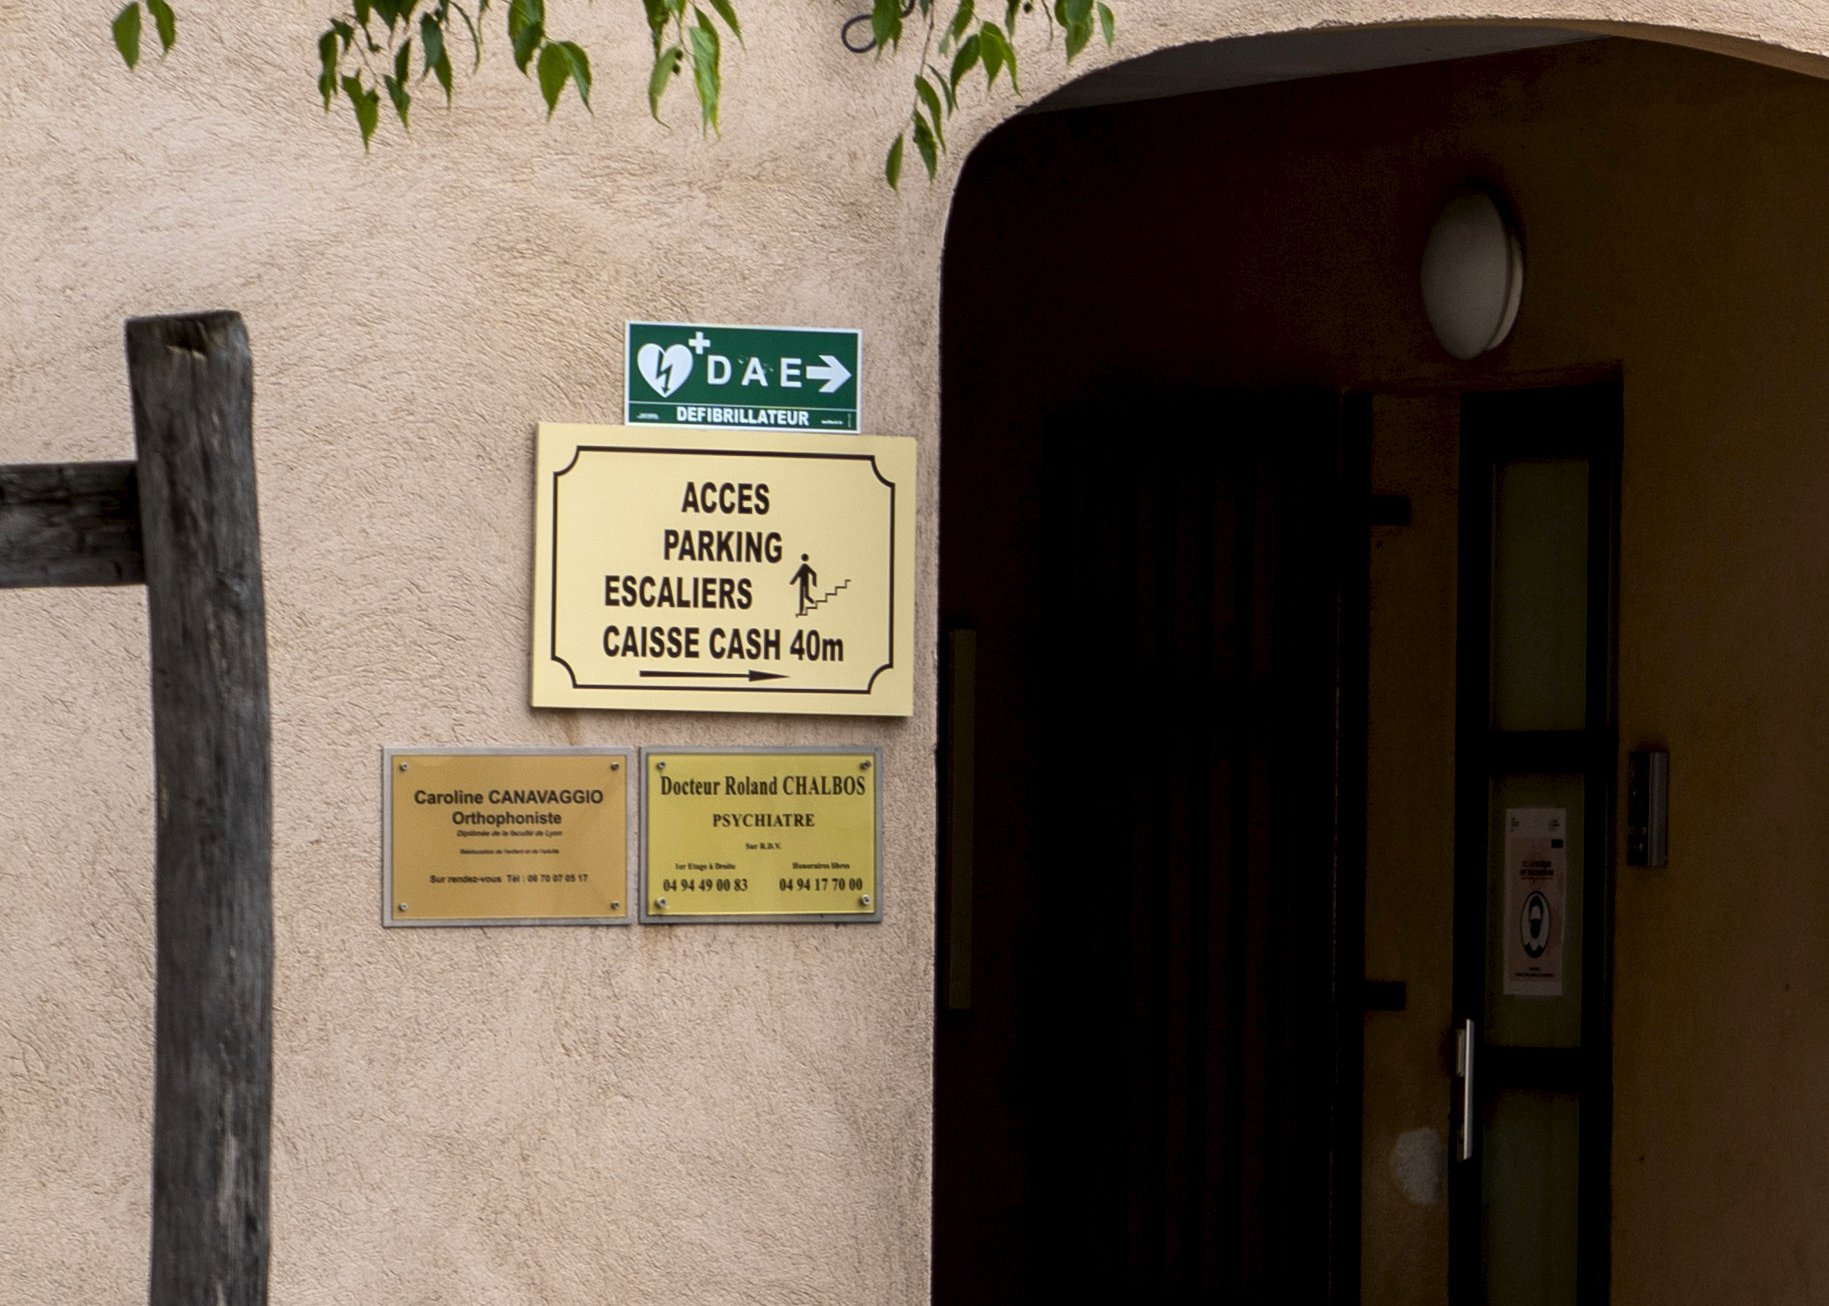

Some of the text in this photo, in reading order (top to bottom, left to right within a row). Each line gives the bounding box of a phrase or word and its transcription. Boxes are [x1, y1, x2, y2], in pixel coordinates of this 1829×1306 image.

[676, 406, 810, 426] DEFIBRILLATEUR
[681, 481, 770, 515] ACCES
[663, 529, 783, 564] PARKING
[604, 575, 753, 610] ESCALIERS
[602, 625, 845, 662] CAISSE CASH 40m
[660, 776, 866, 795] Docteur Roland CHALBOS
[414, 790, 604, 805] Caroline CANAVAGGIO
[452, 811, 562, 827] Orthophoniste
[712, 813, 815, 828] PSYCHIATRE
[430, 874, 446, 883] Sur
[448, 875, 502, 883] rendez-vous
[663, 879, 748, 892] 04 94 49 00 83
[779, 878, 863, 891] 04 94 17 70 00
